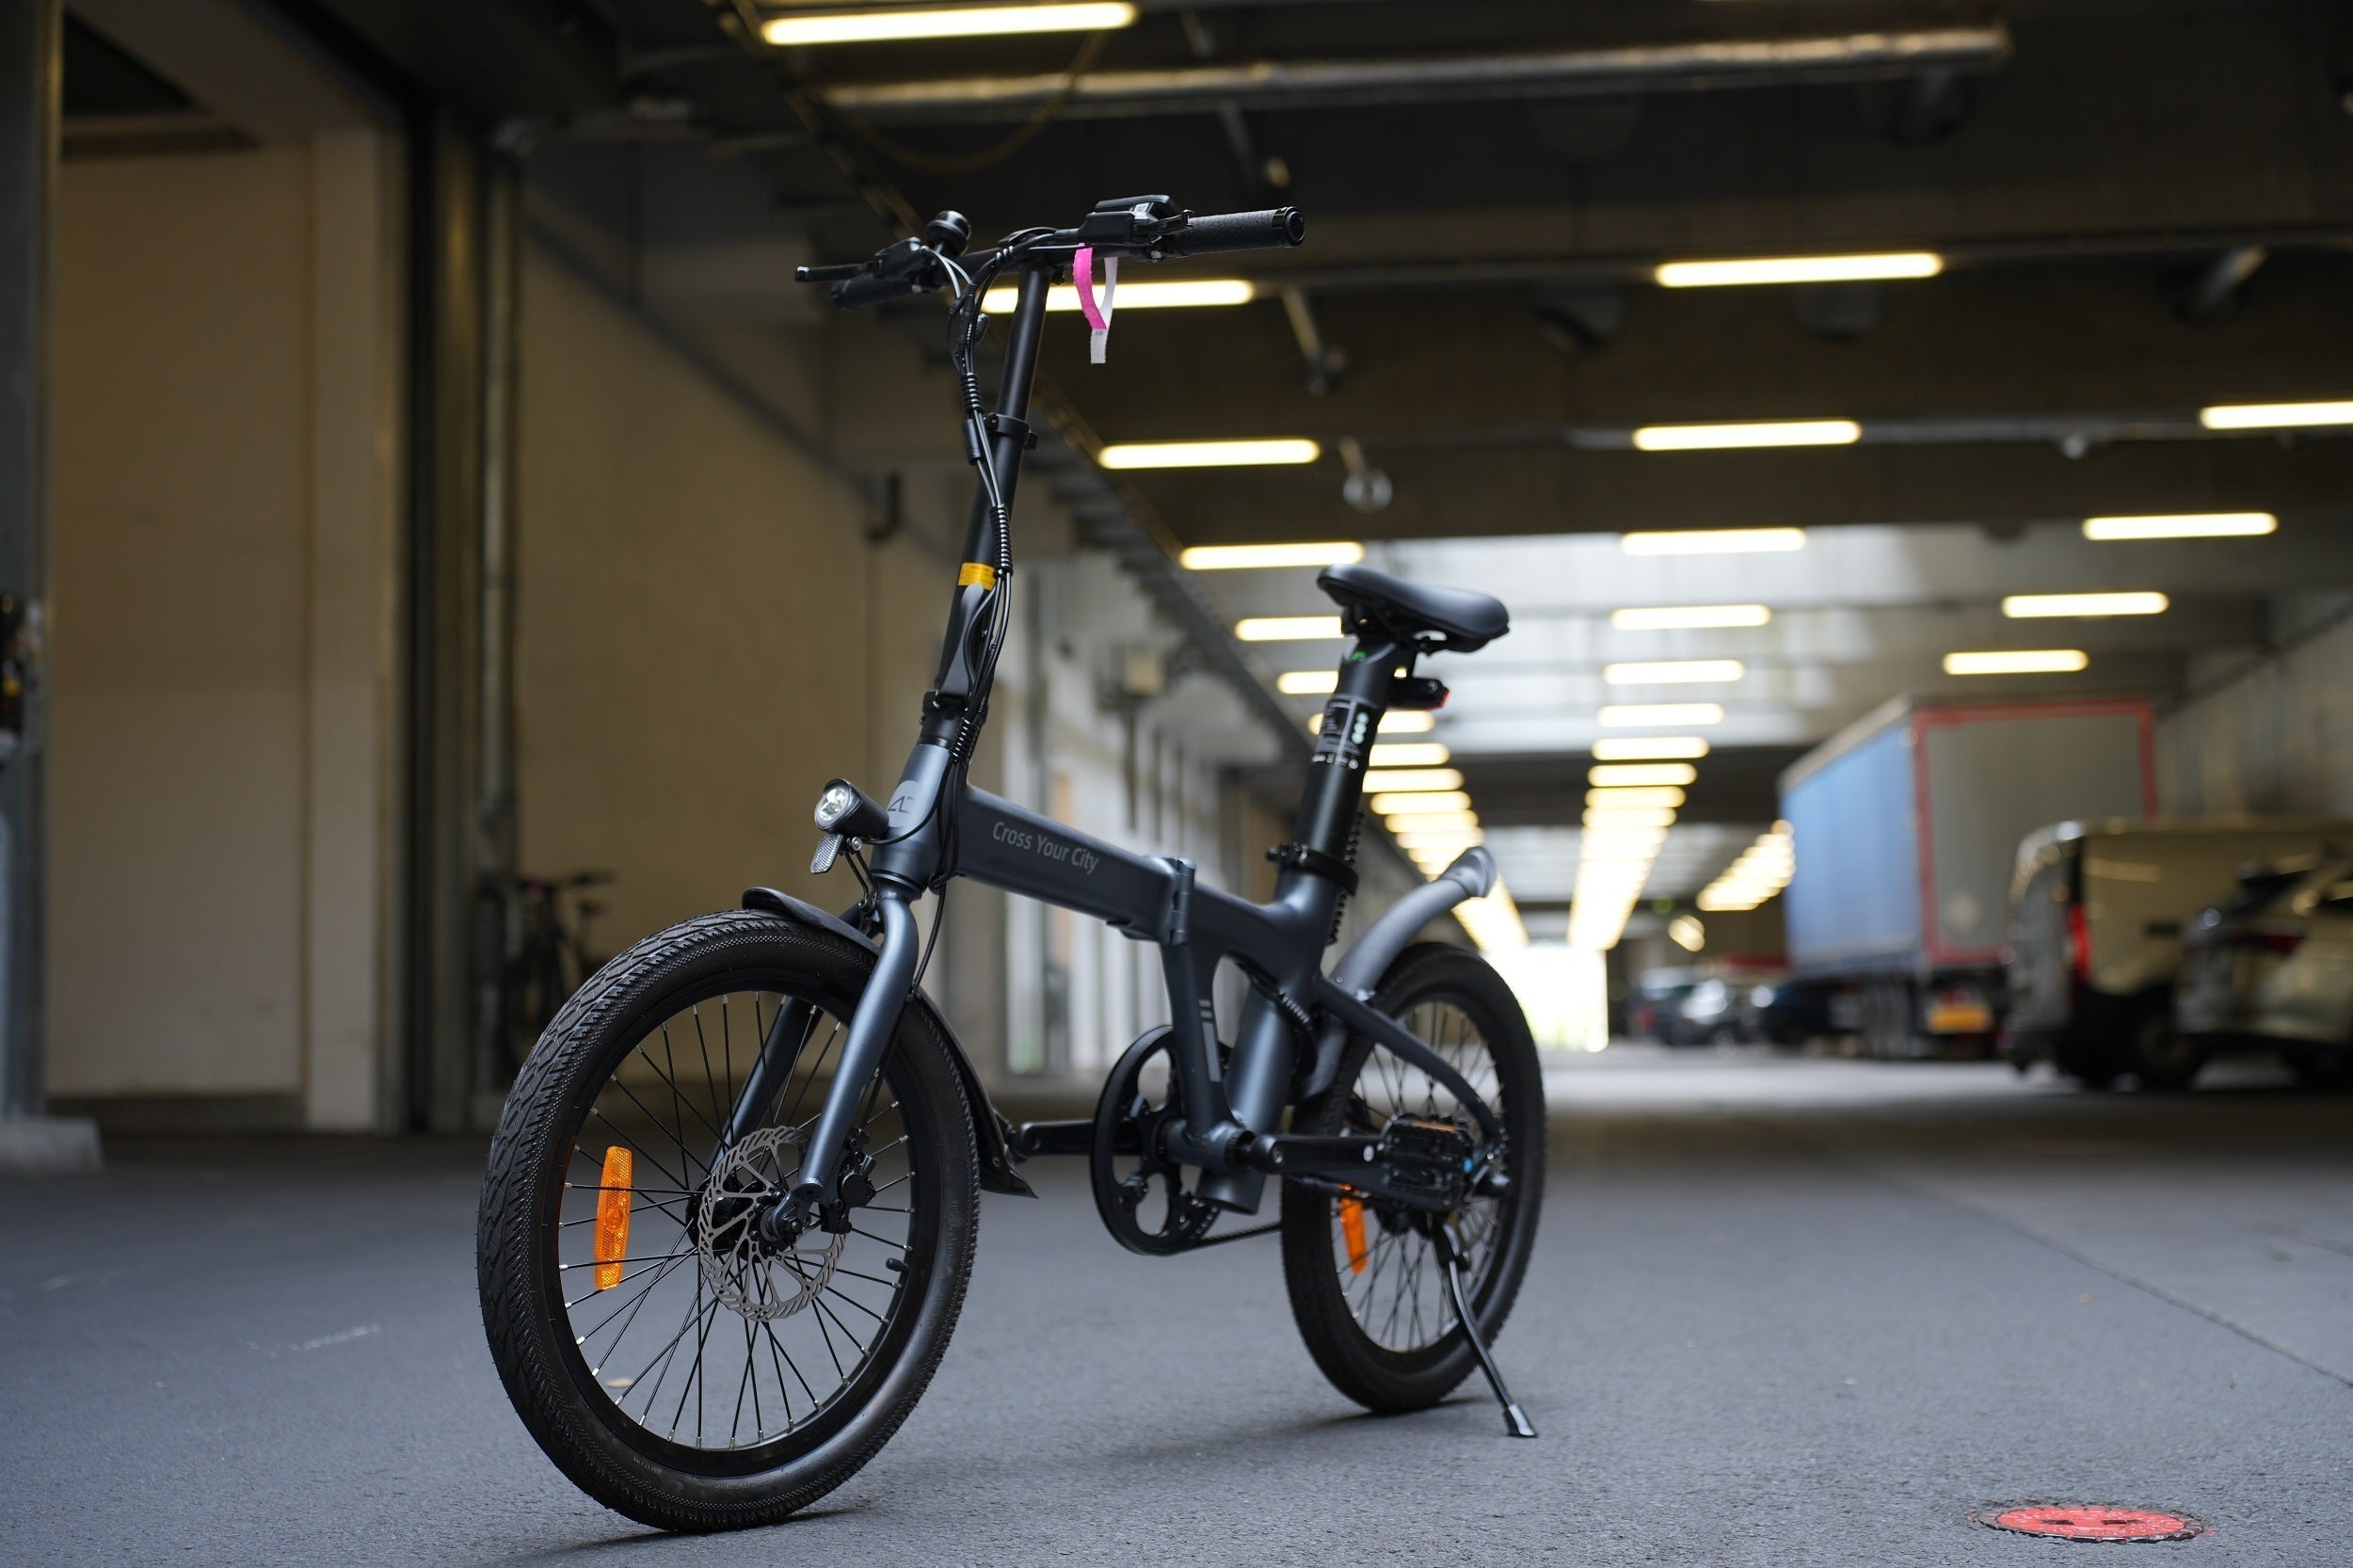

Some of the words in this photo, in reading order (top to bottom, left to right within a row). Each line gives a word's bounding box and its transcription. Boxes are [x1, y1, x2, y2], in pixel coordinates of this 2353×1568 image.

[992, 821, 1032, 850] Cross
[1036, 835, 1069, 861] Your
[1071, 848, 1099, 874] City
